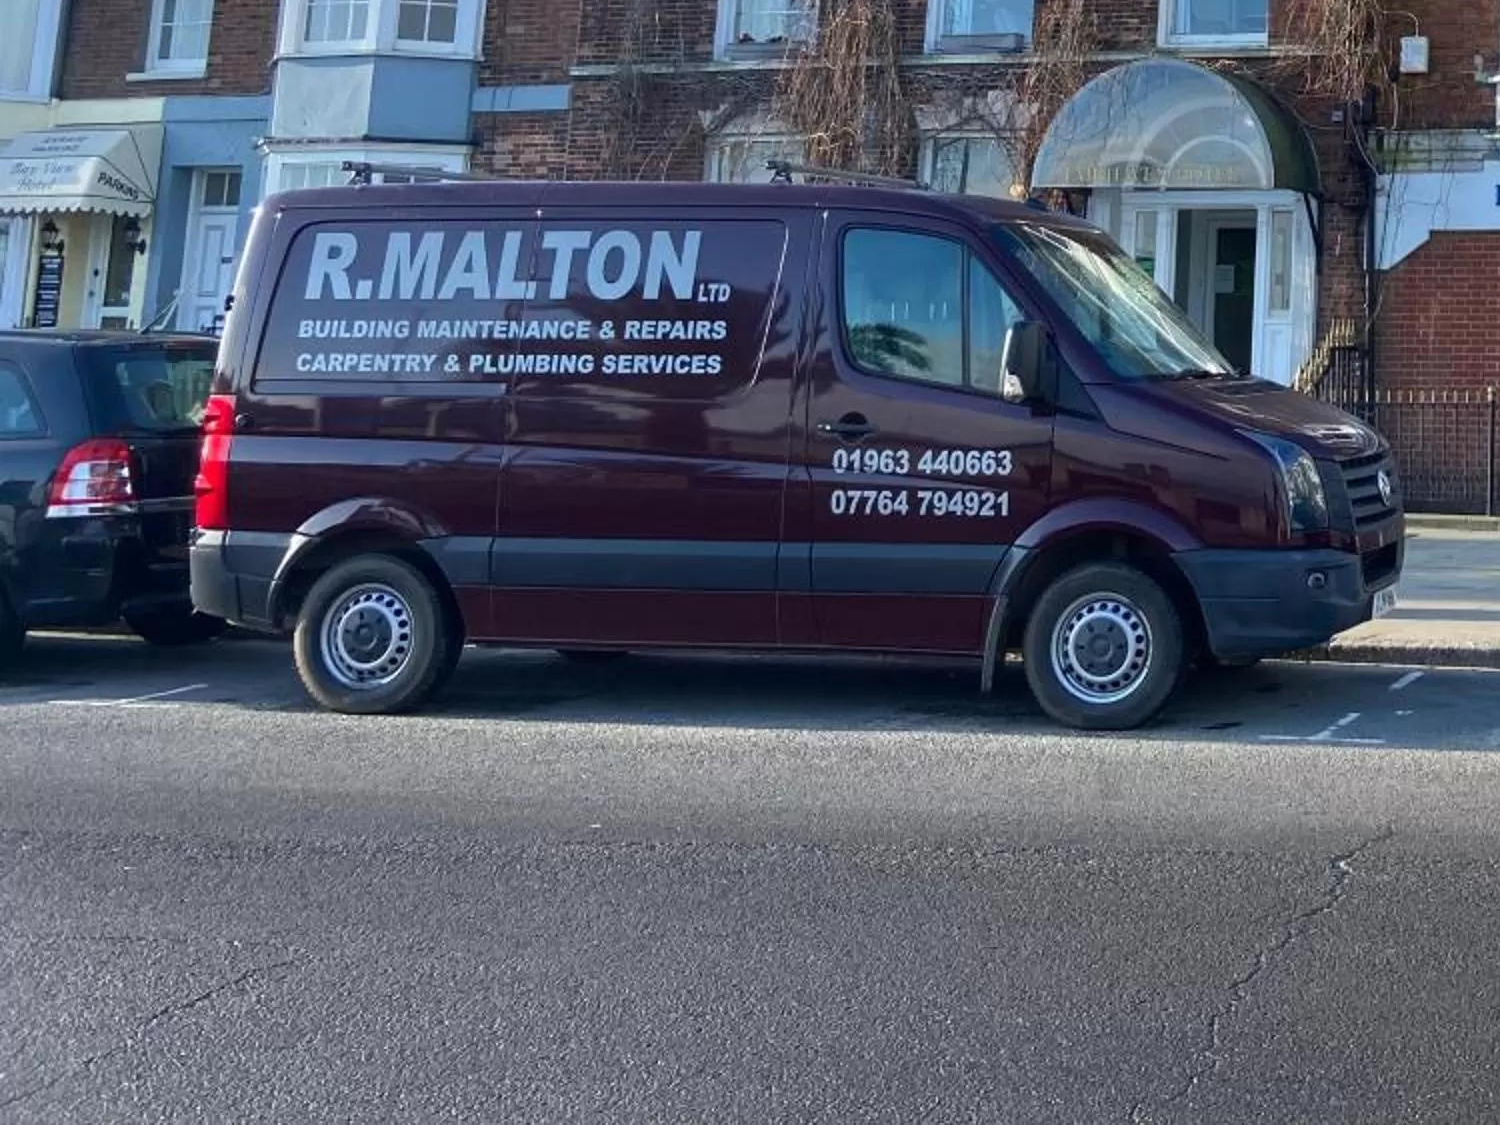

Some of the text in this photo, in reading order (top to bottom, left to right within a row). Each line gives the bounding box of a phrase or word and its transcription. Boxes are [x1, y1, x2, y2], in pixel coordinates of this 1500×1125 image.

[304, 230, 730, 303] R.MALTON LTD
[297, 320, 728, 341] BUILDING MAINTENANCE & REPAIRS
[296, 354, 723, 375] CARPENTRY & PLUMBING SERVICES
[832, 449, 1013, 476] 01963 440663
[831, 490, 1010, 516] 07764 794921
